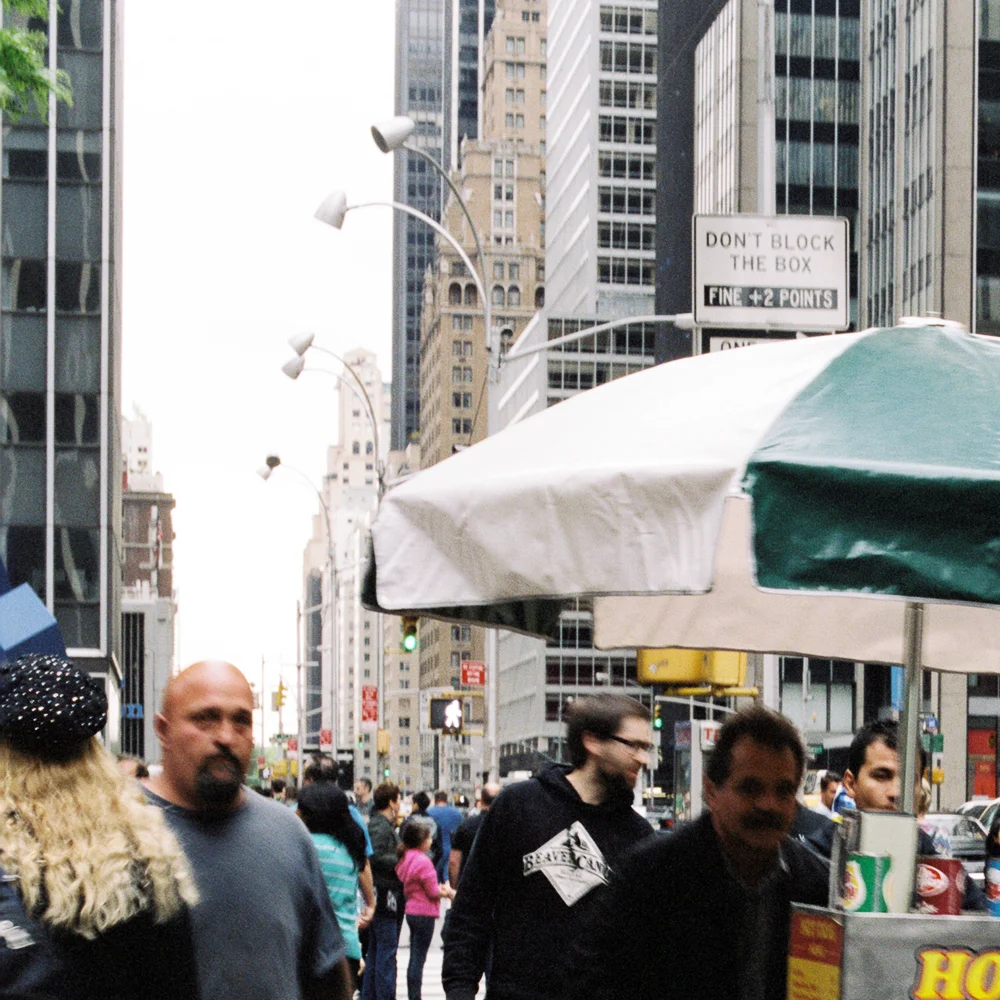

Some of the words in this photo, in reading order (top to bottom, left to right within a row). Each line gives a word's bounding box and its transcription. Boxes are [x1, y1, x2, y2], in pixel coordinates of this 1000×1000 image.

[705, 231, 762, 249] DON'T
[771, 233, 835, 252] BLOCK
[730, 254, 767, 272] THE
[775, 256, 812, 273] BOX
[708, 287, 743, 306] FINE
[749, 287, 774, 307] +2
[779, 289, 834, 309] POINTS
